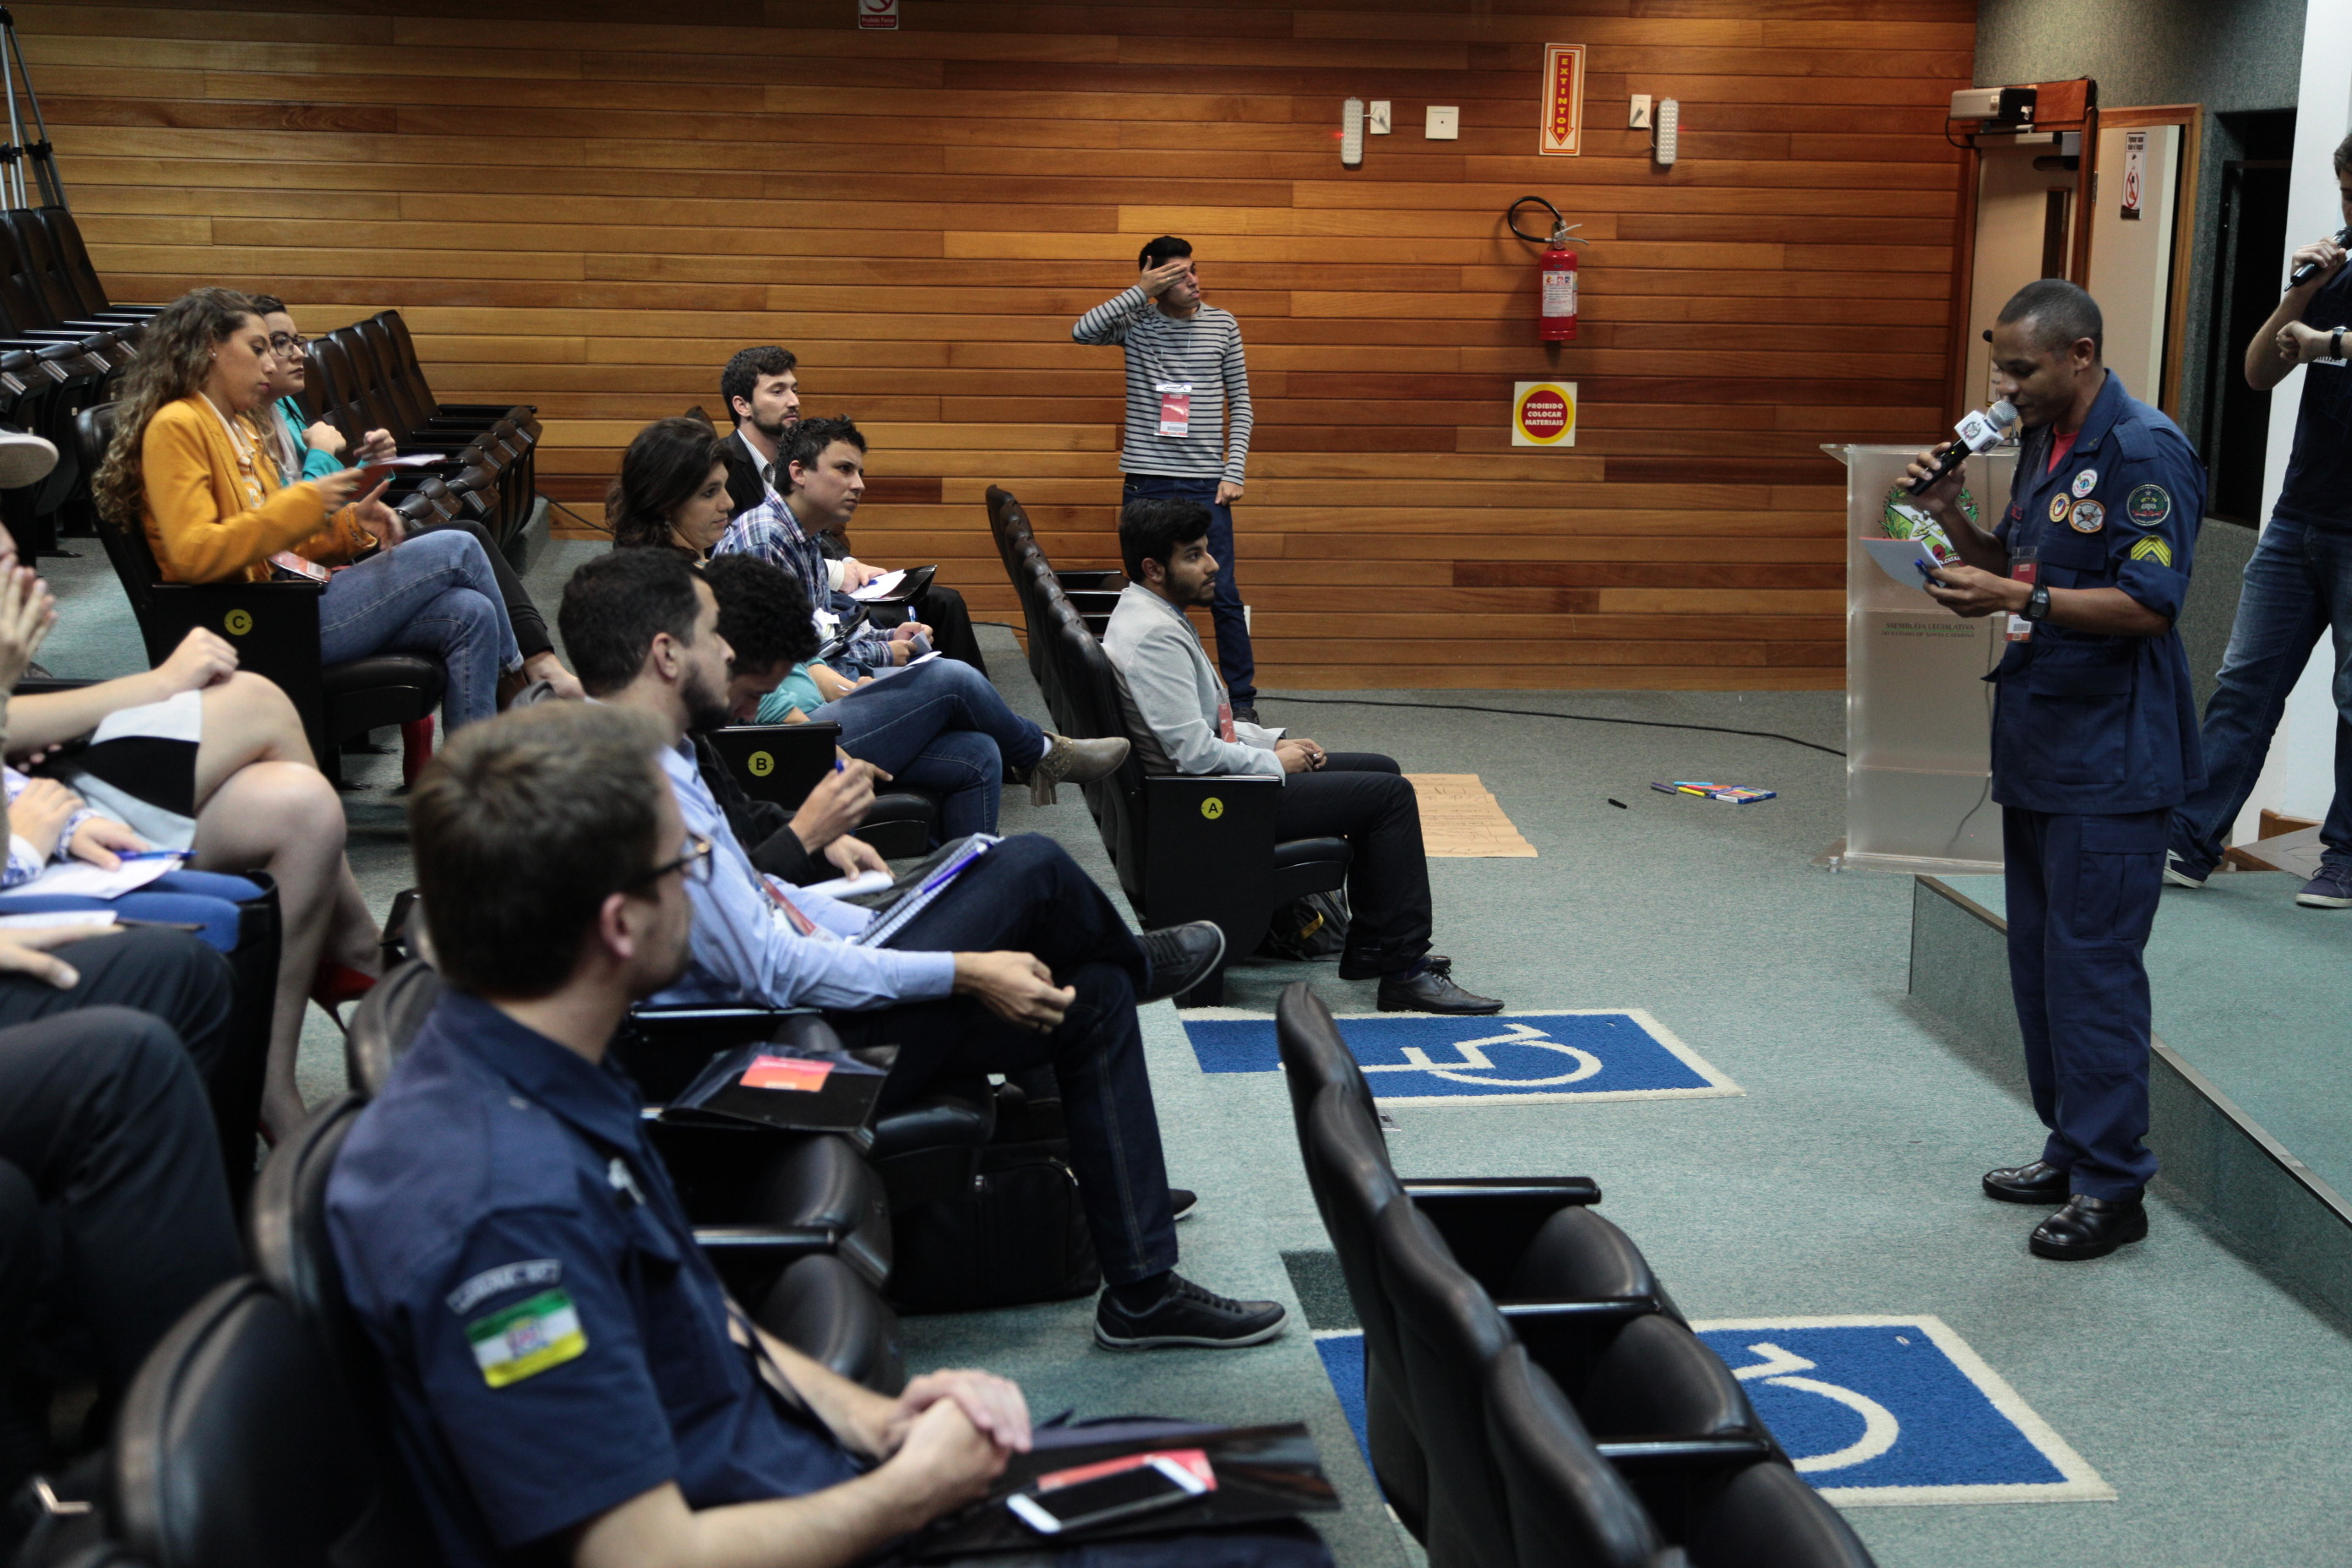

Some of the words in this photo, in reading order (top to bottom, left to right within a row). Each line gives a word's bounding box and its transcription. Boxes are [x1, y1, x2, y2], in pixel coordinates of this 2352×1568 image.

[1556, 57, 1570, 134] EXTINTOR
[232, 615, 245, 629] C
[756, 757, 767, 770] B
[1208, 802, 1218, 814] A
